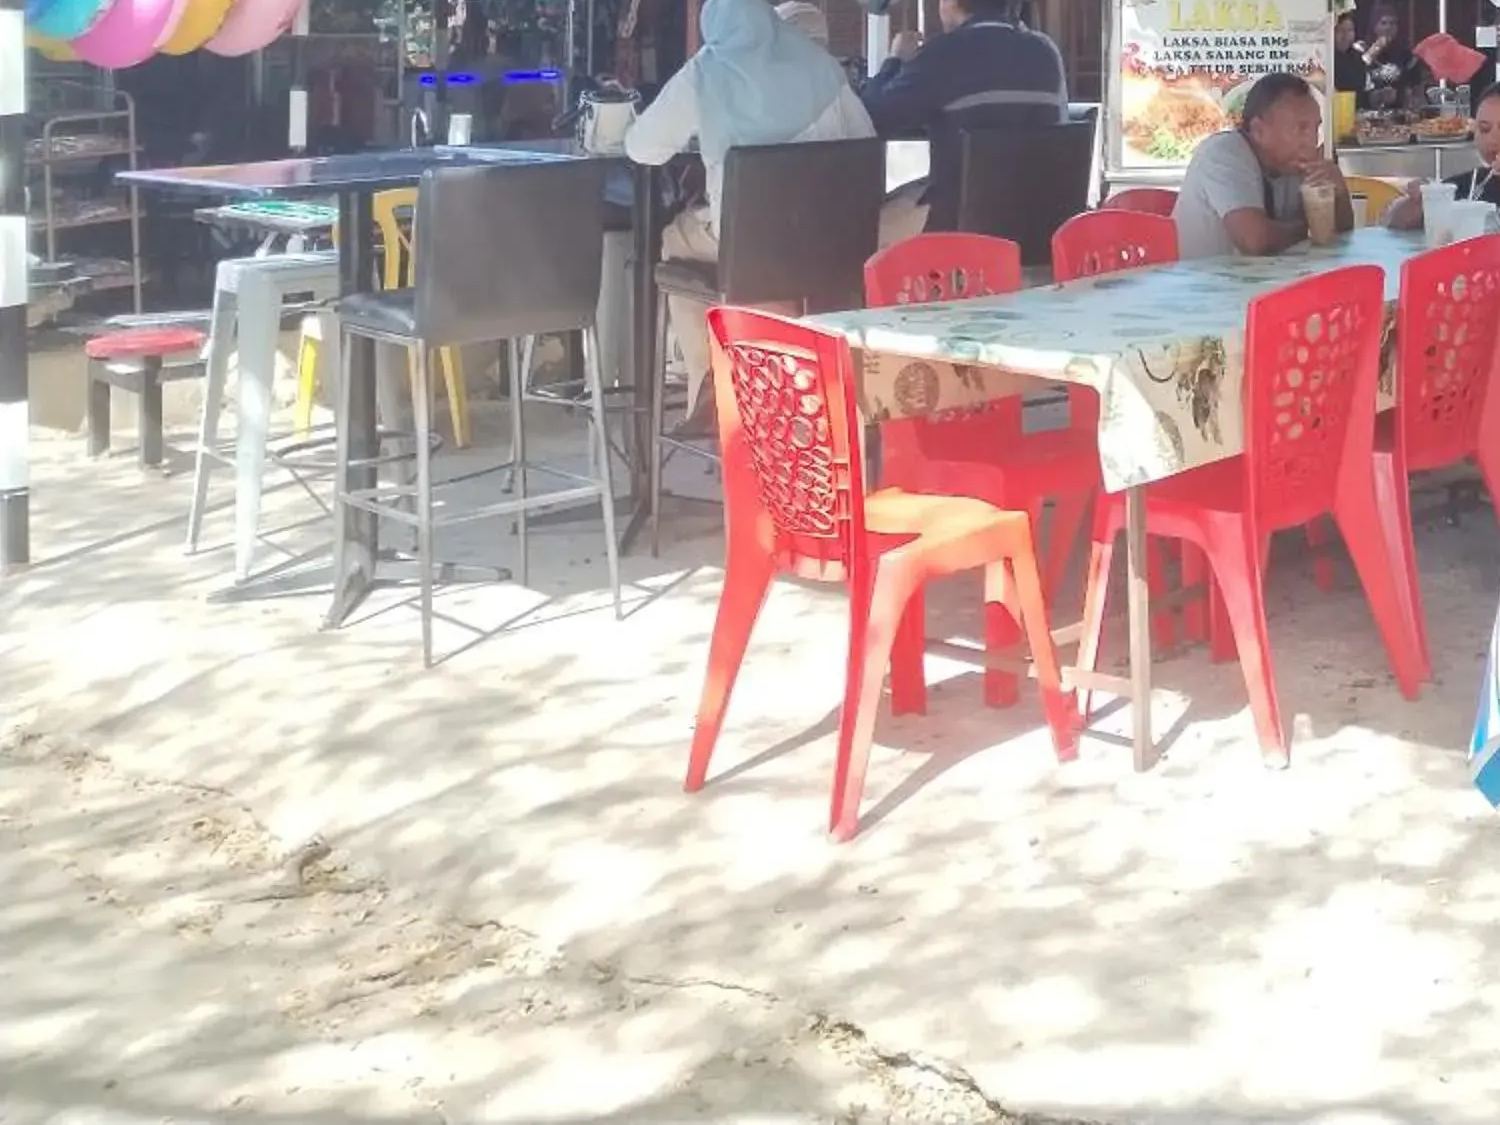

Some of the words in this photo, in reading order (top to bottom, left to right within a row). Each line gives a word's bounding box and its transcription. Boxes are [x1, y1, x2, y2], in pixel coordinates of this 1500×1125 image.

[1162, 36, 1209, 47] LAKSA
[1214, 36, 1257, 47] BIASA
[1261, 36, 1289, 48] RM5
[1154, 50, 1201, 60] LAKSA
[1206, 50, 1265, 60] SARANG
[1190, 64, 1234, 74] TELUR
[1239, 64, 1282, 74] SEBIJI
